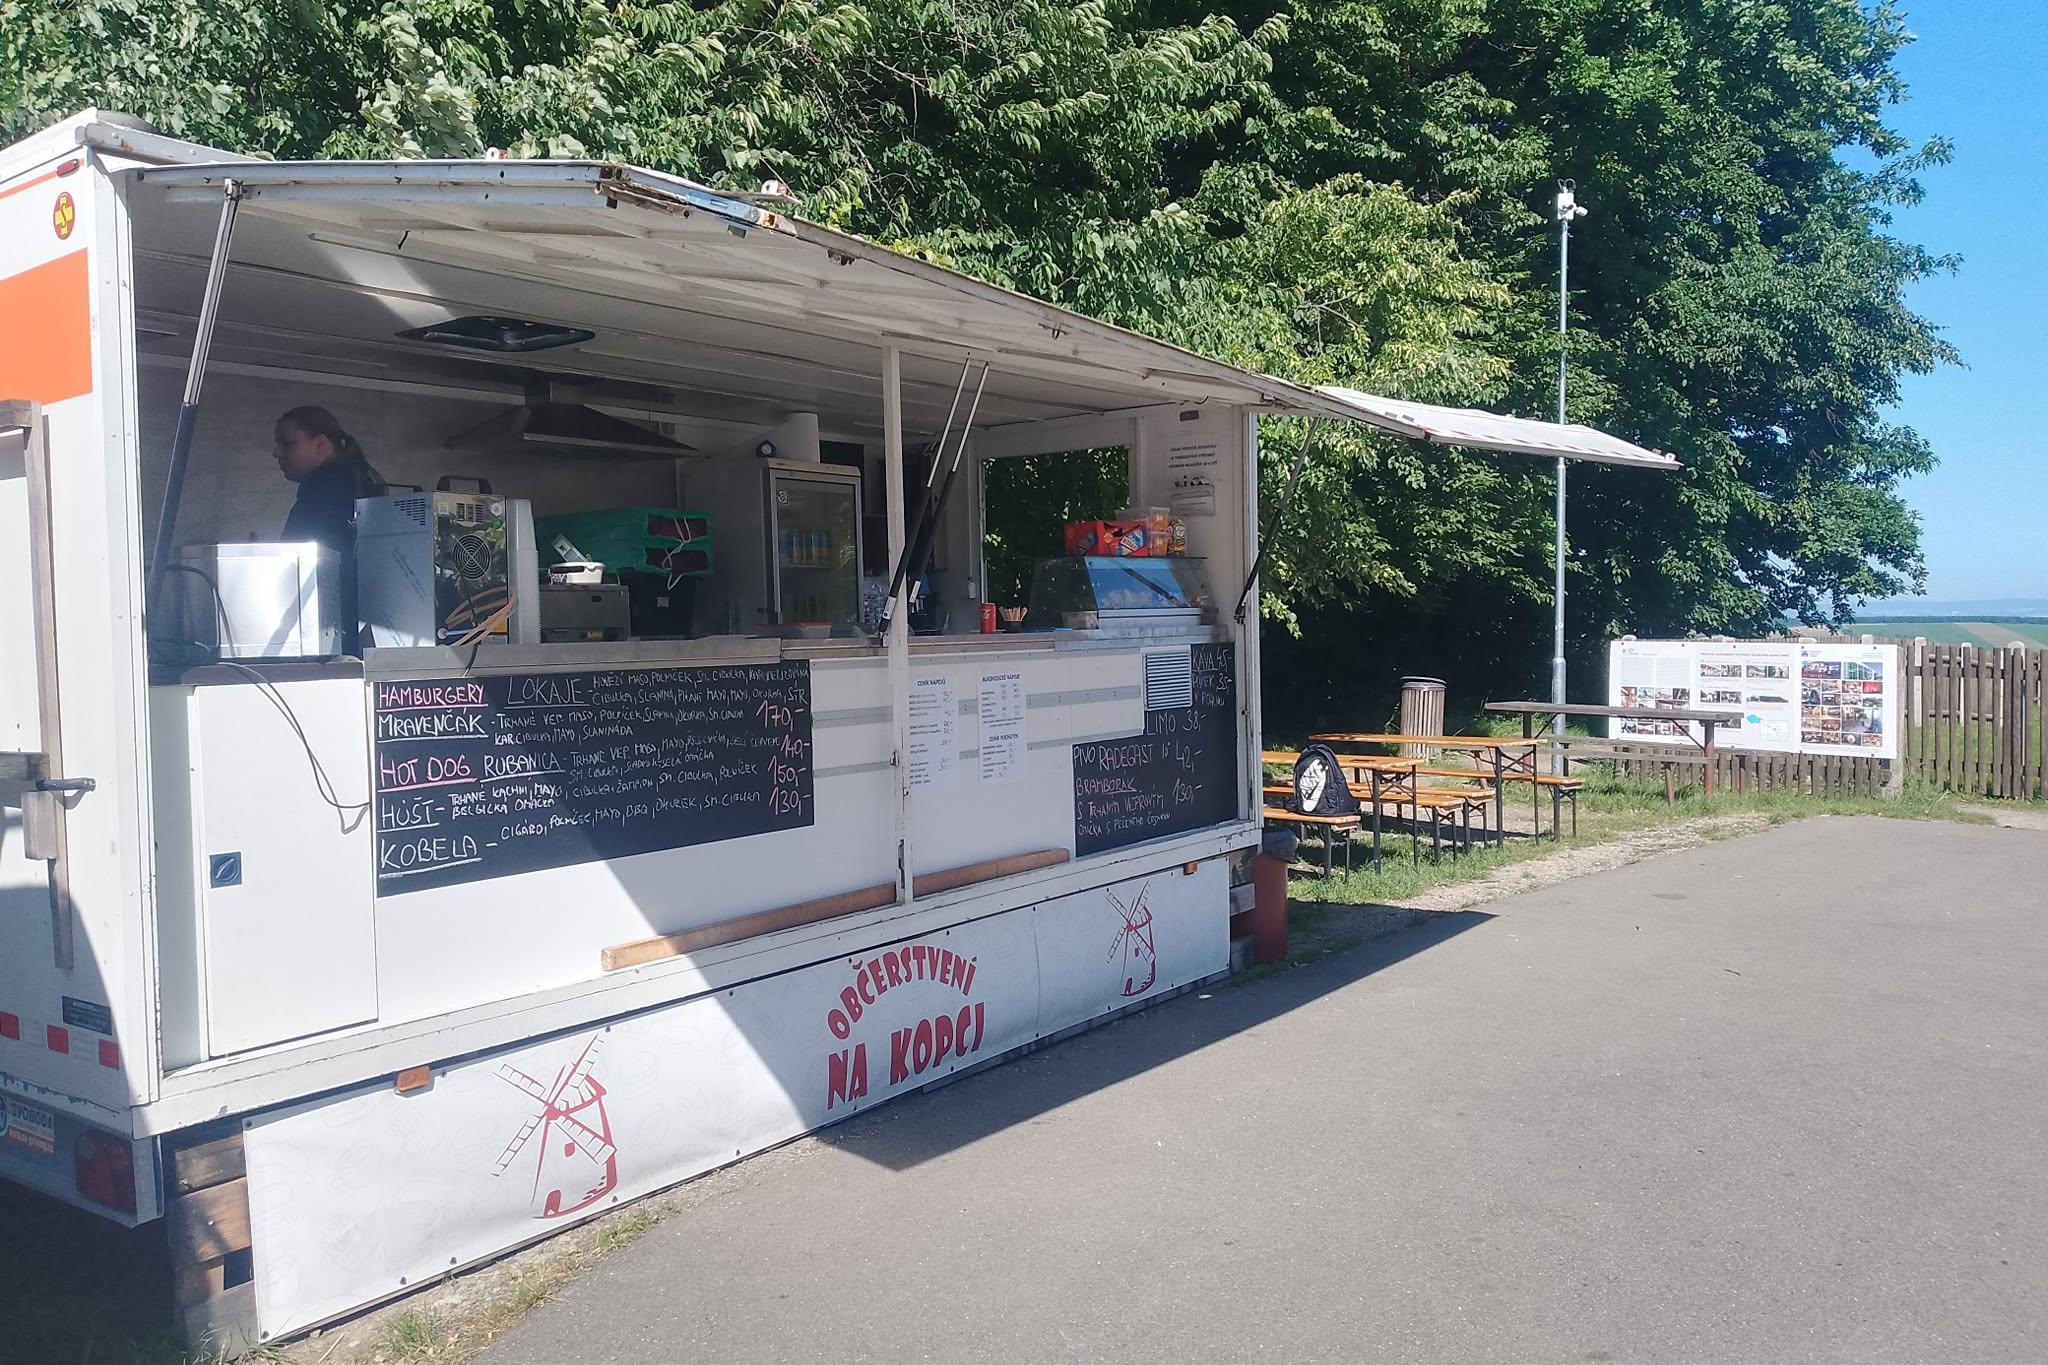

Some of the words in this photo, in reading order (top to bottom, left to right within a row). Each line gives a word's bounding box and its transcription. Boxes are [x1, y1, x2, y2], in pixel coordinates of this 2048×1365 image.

[378, 682, 485, 708] HAMBURGERY
[508, 677, 584, 704] LOKAJE
[378, 708, 486, 739] MRAVENČÁK
[1147, 712, 1176, 736] LIMO
[380, 754, 418, 787] HOT
[427, 754, 471, 782] DOG
[484, 752, 562, 777] RUBANICA
[1074, 745, 1096, 770] PIVO
[1100, 744, 1153, 771] RADEGAST
[380, 835, 478, 869] KOBELA
[827, 944, 978, 1040] OBČERSTVENÍ
[827, 1042, 868, 1110] NA
